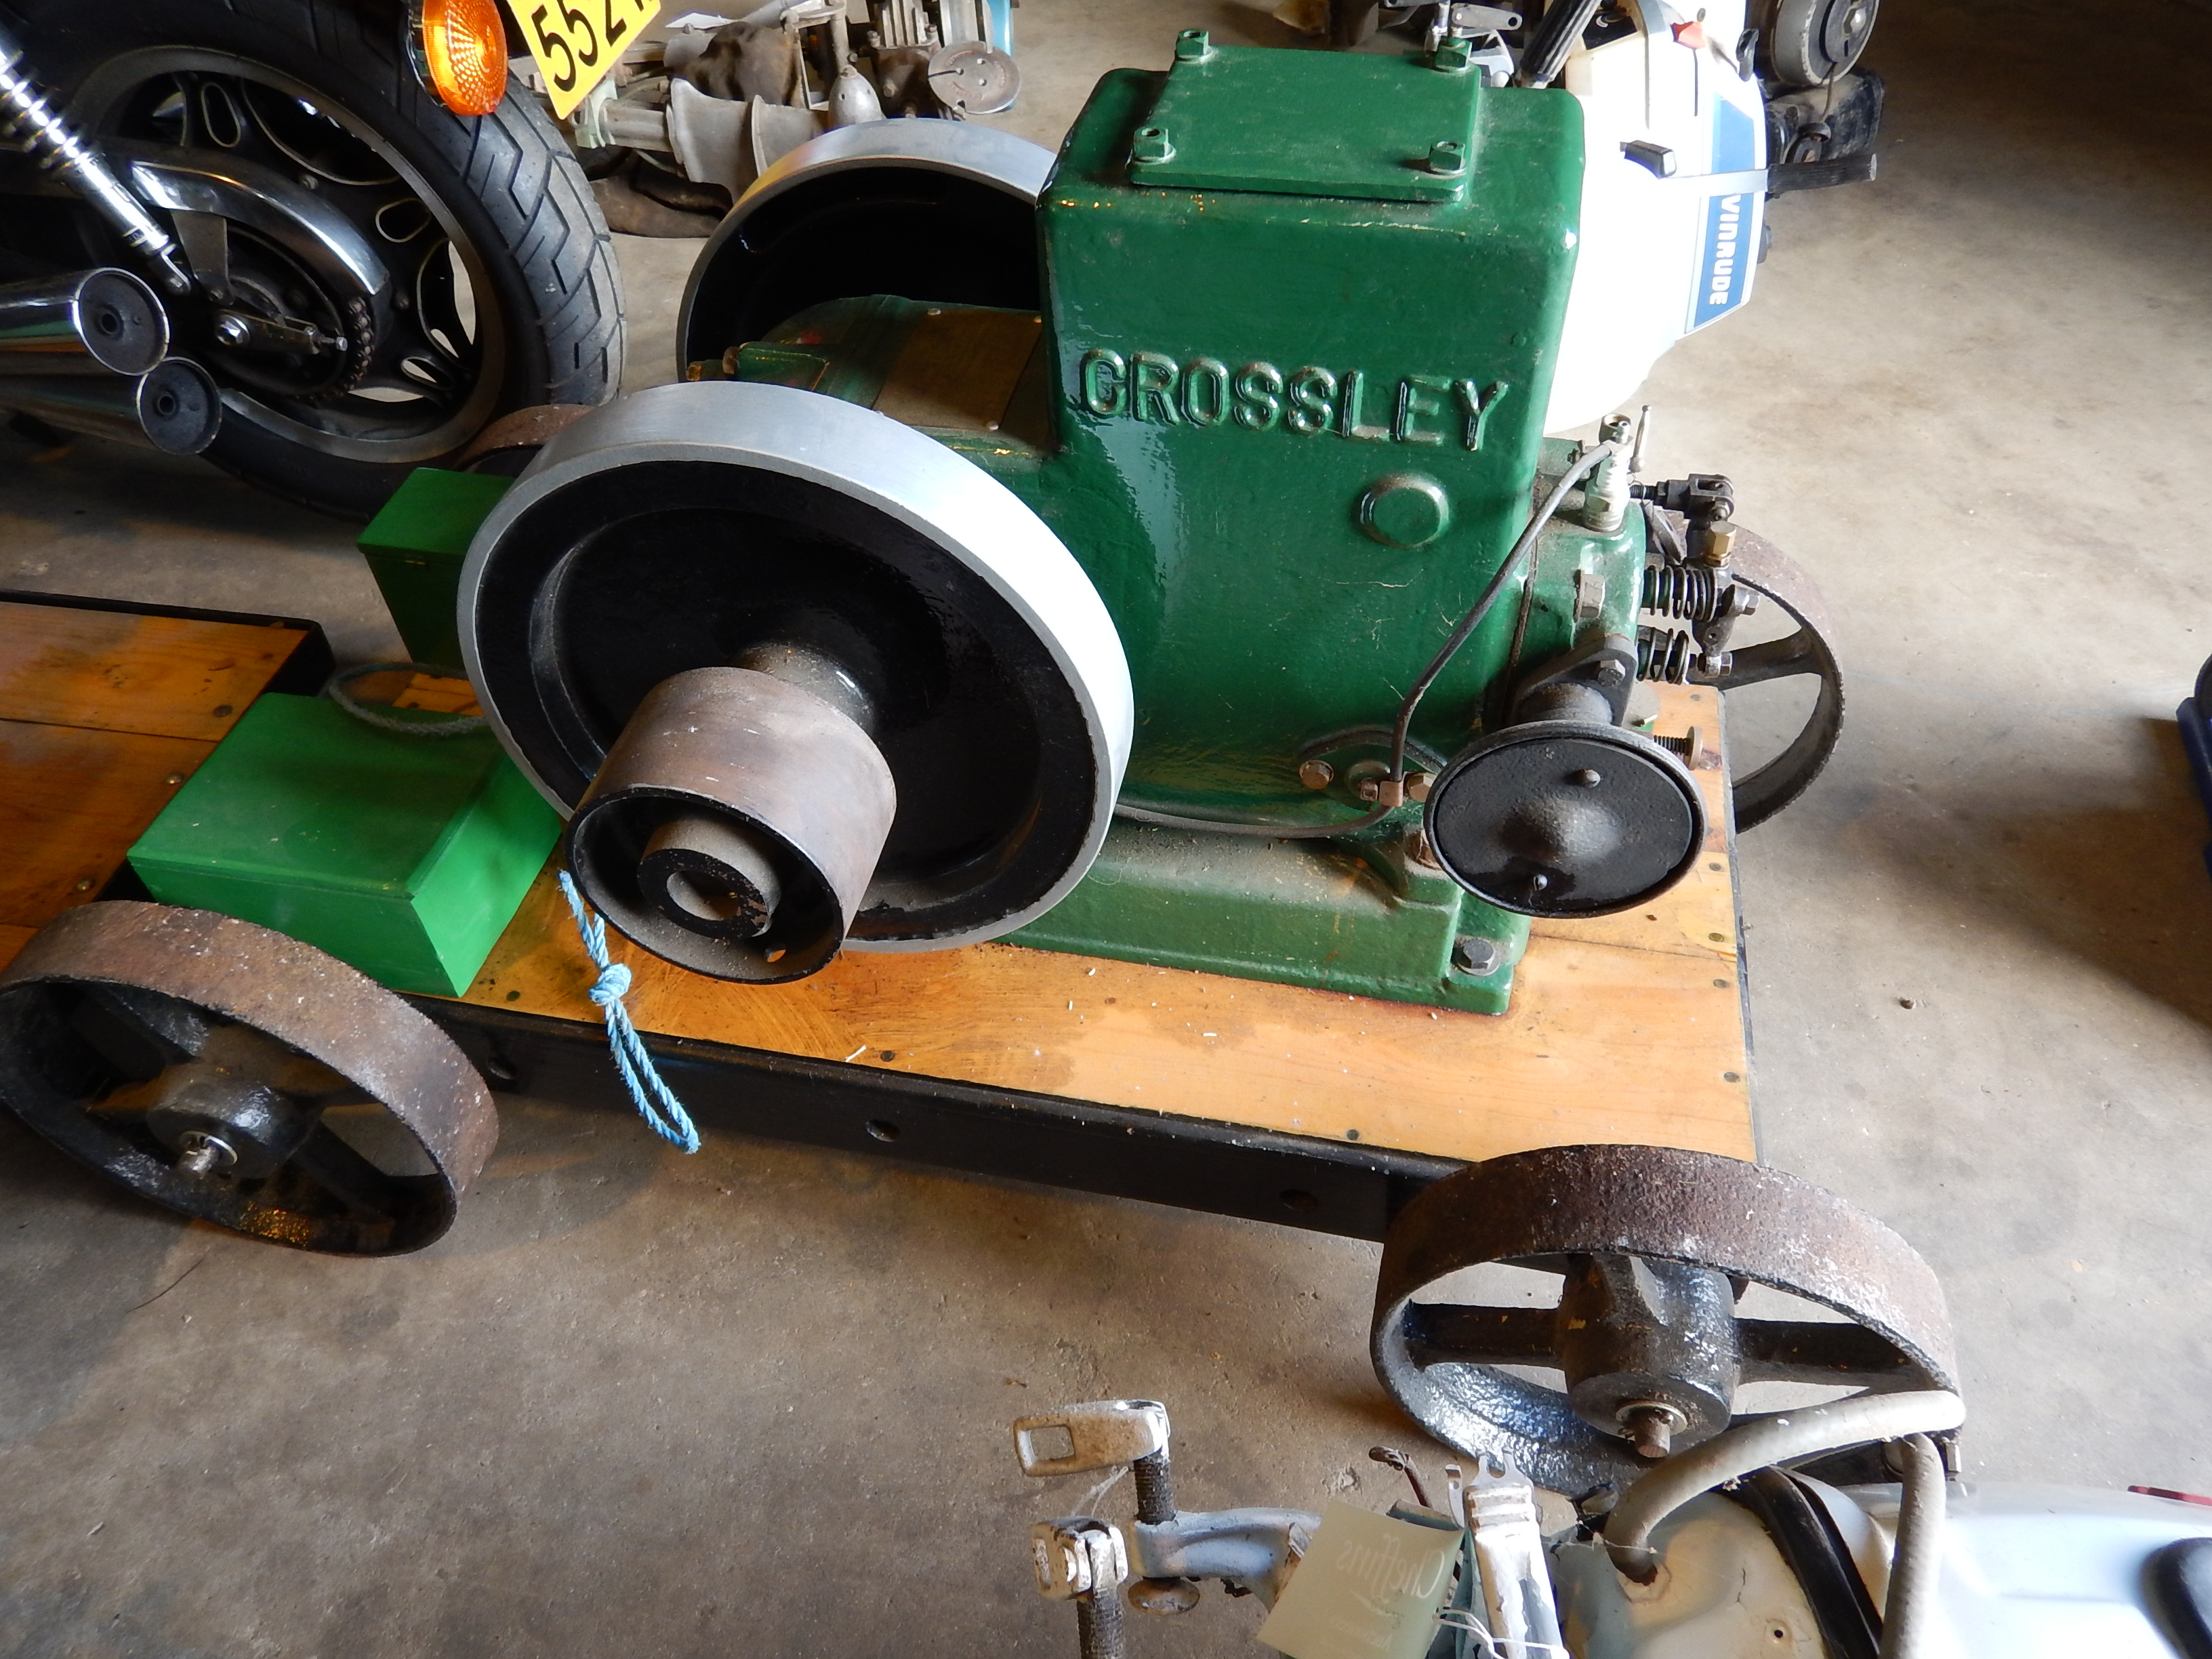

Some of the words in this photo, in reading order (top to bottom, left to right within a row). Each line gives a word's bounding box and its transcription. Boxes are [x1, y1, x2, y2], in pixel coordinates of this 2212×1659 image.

[531, 0, 644, 92] 552
[1709, 194, 1741, 305] VINRUDE
[1080, 347, 1509, 451] CROSSLEY
